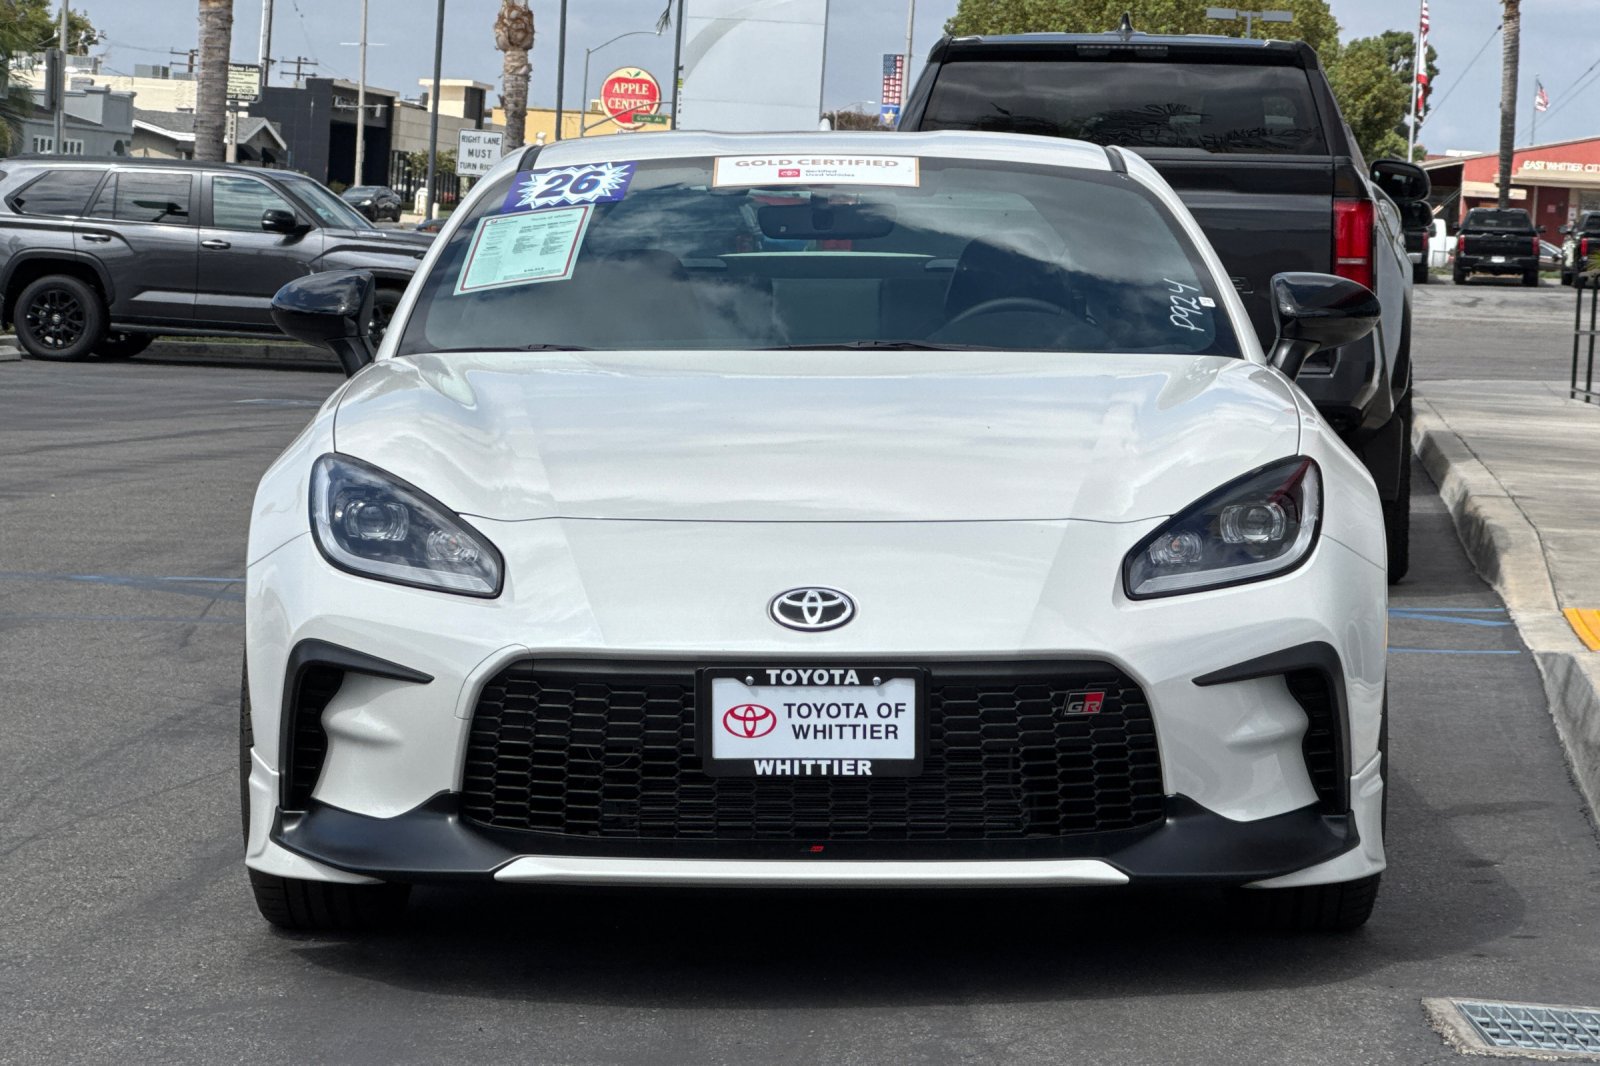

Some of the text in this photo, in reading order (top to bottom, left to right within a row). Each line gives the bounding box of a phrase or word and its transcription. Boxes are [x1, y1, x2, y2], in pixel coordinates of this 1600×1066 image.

[612, 82, 649, 95] APPLE
[607, 97, 650, 111] CENTER
[461, 135, 501, 145] RIGHT LANE
[467, 149, 492, 159] MUST
[460, 162, 477, 170] TURN
[735, 159, 899, 167] GOLD CERTIFIED
[1523, 160, 1546, 170] EAST
[535, 171, 605, 199] 26
[766, 669, 860, 685] TOYOTA
[784, 703, 907, 719] TOYOTA OF
[1068, 701, 1100, 712] GR
[791, 724, 899, 740] WHITTIER
[754, 760, 873, 776] WHITTIER
